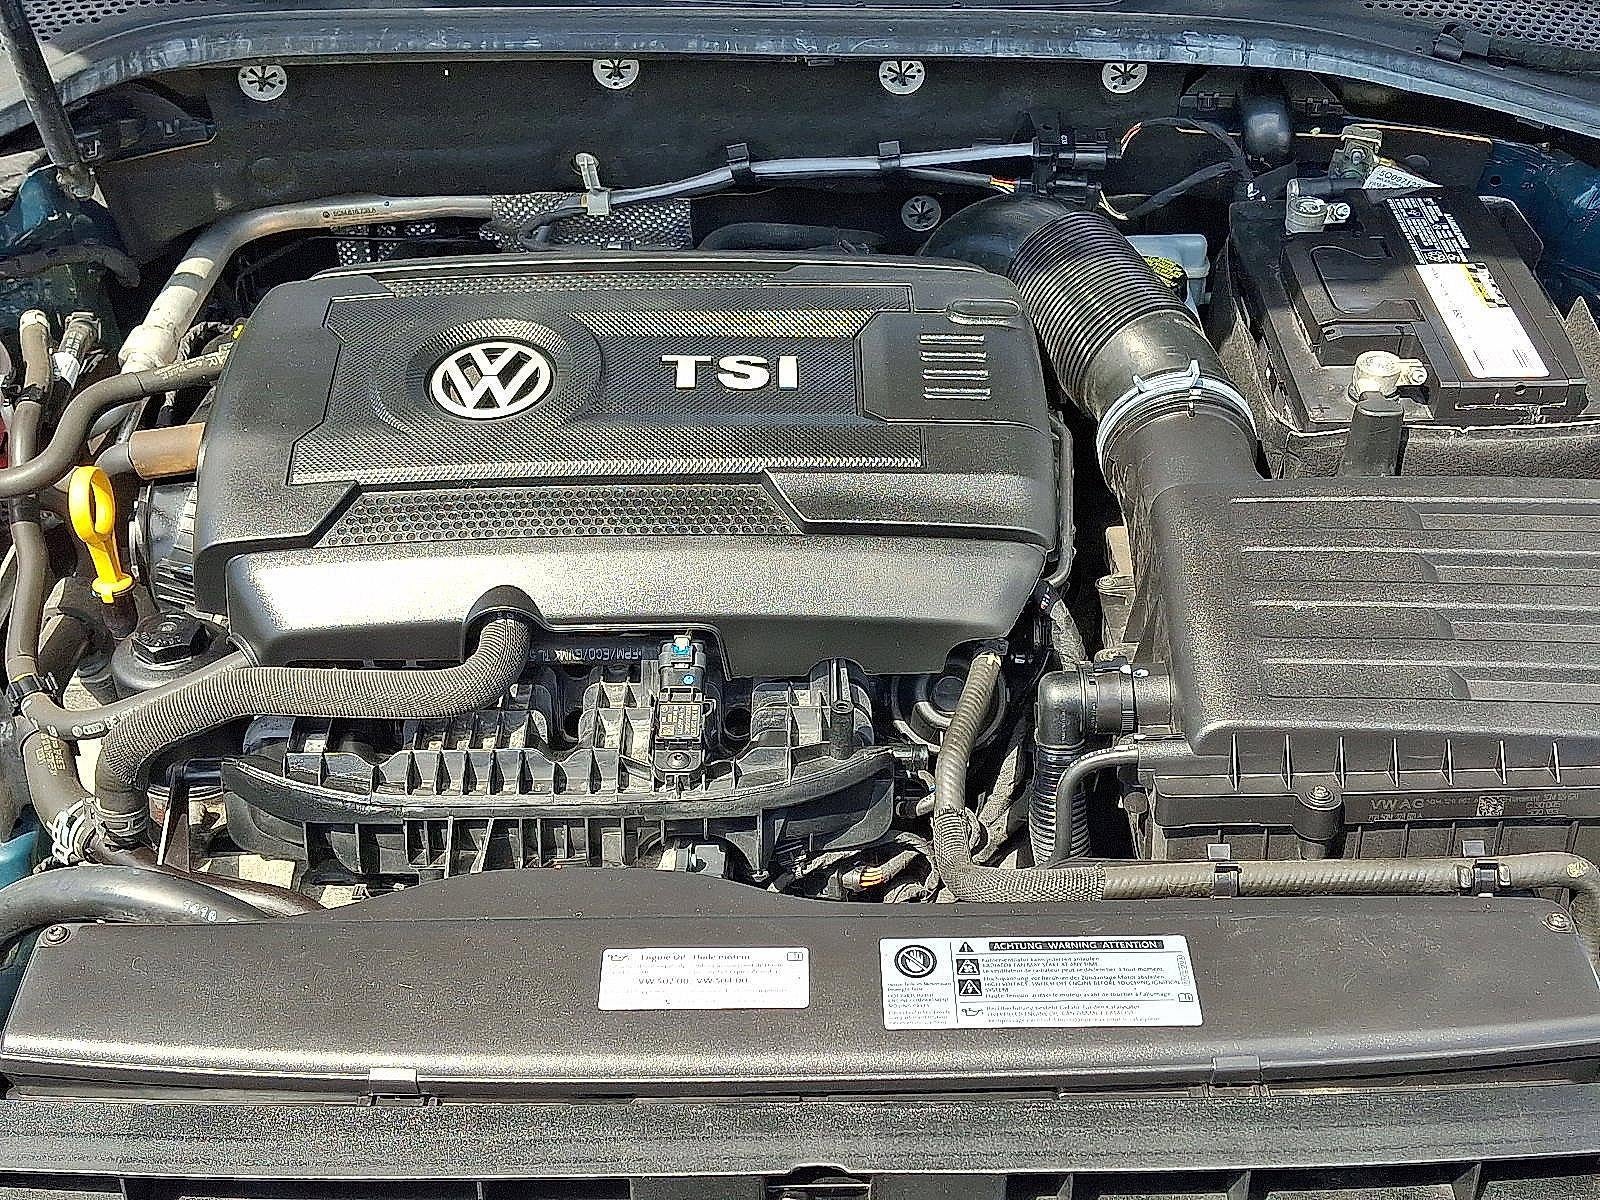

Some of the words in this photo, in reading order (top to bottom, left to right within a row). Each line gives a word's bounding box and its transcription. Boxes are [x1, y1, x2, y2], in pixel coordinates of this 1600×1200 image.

[661, 354, 799, 390] TSI
[1370, 799, 1399, 811] VW
[1400, 798, 1425, 809] AG
[993, 942, 1043, 950] ACHTUNG
[1047, 941, 1097, 950] WARNING
[1102, 940, 1157, 950] ATTENTION
